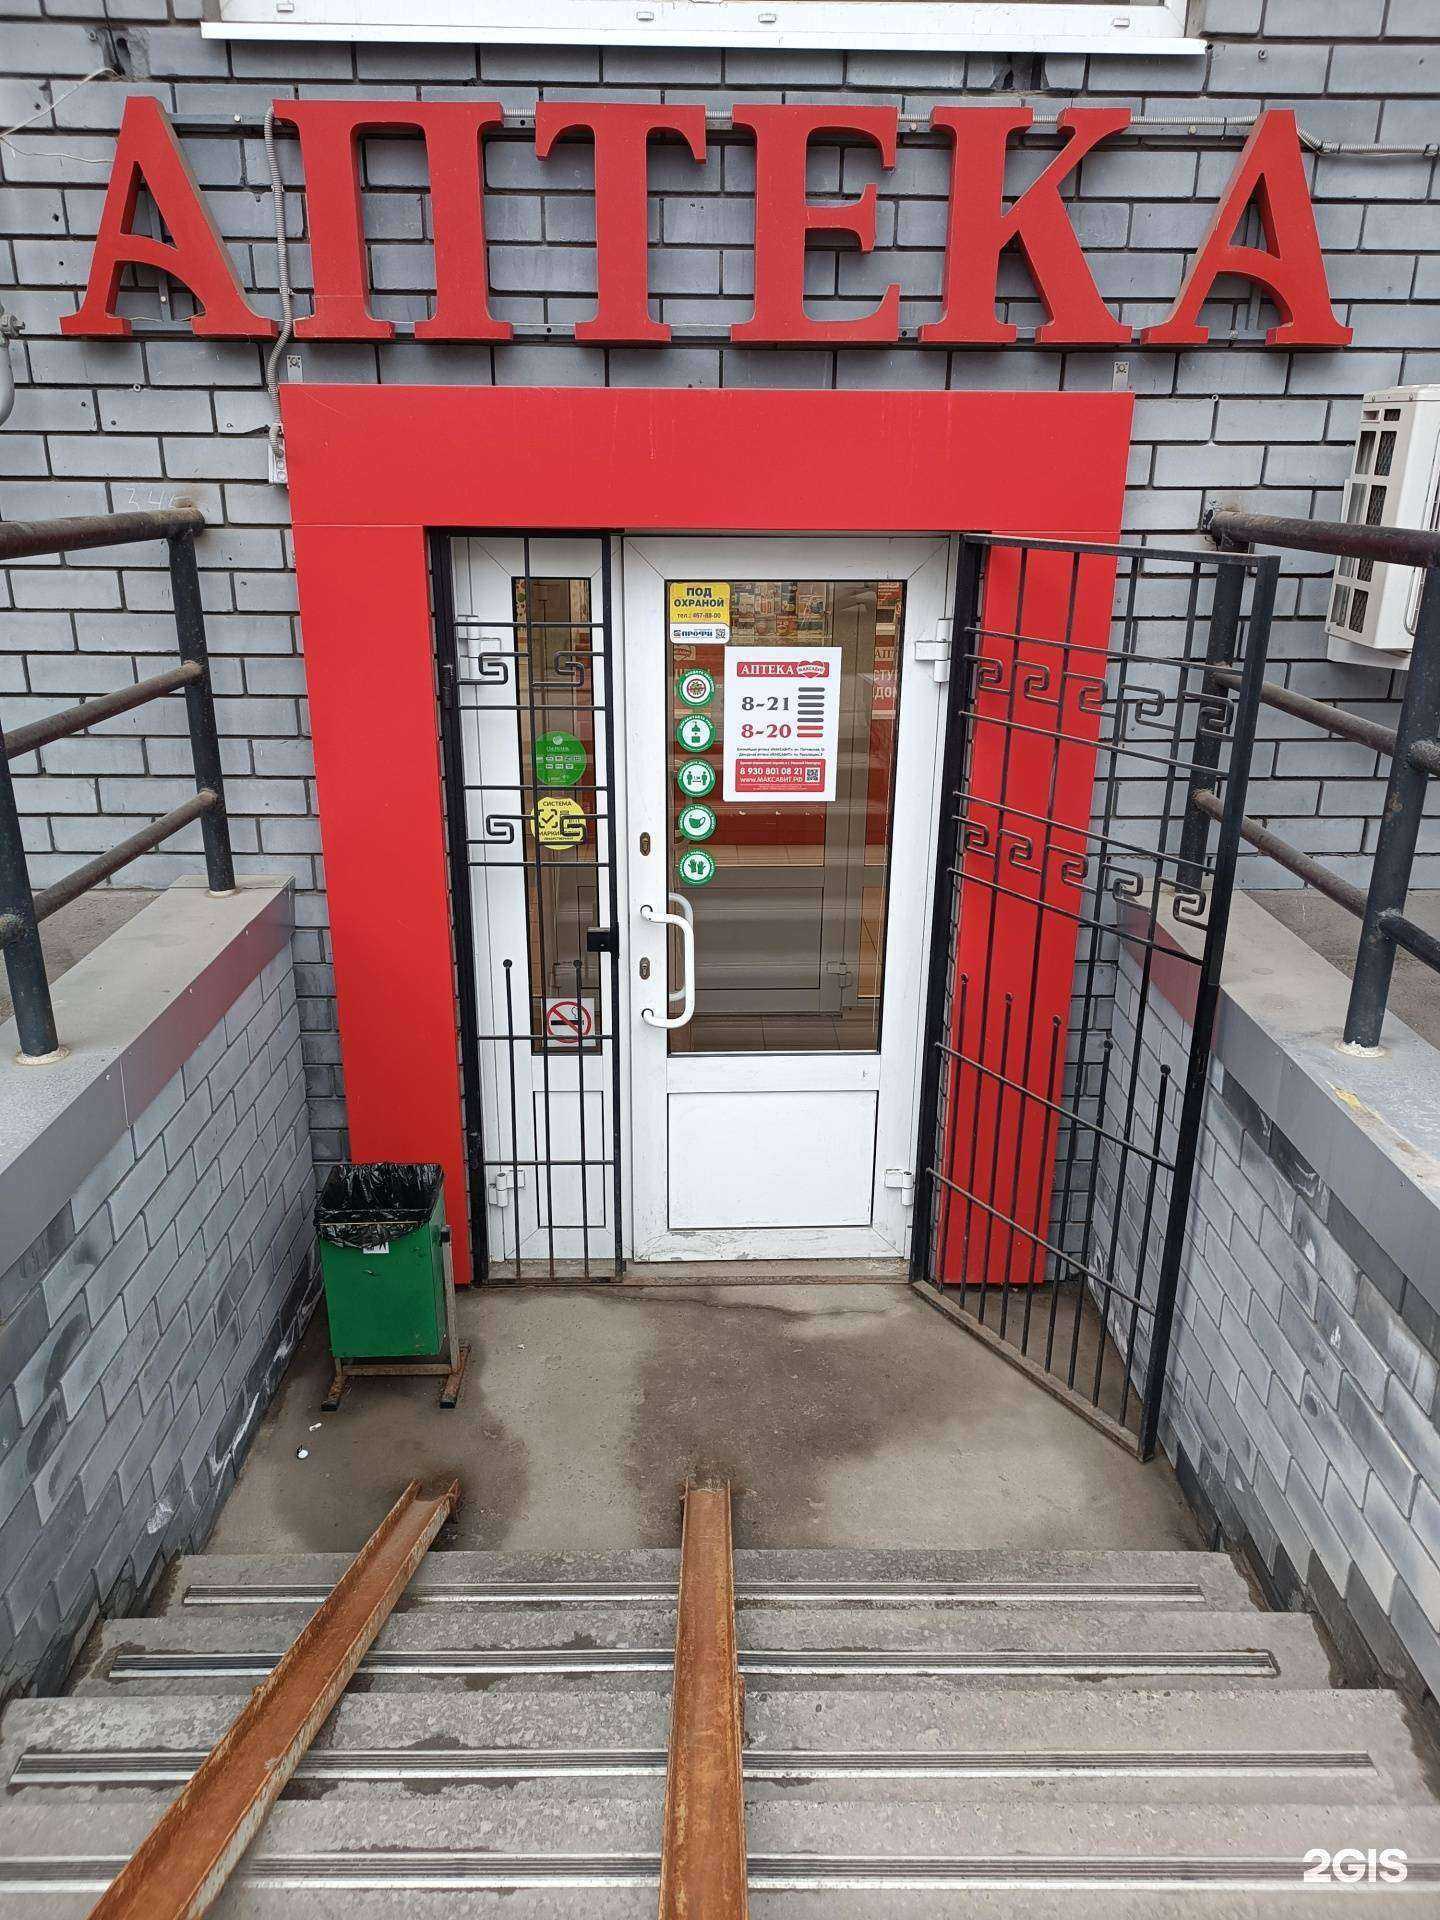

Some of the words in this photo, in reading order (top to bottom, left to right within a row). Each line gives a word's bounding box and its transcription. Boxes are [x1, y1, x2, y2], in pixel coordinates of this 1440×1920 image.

[59, 96, 1353, 347] АПТЕКА
[686, 587, 713, 598] ПОД
[673, 597, 725, 607] ОХРАНОЙ
[741, 664, 794, 675] АПТЕКА
[739, 767, 745, 775] 8
[747, 767, 762, 775] 930
[765, 767, 779, 775] 801
[781, 767, 792, 775] 08
[794, 767, 803, 775] 21
